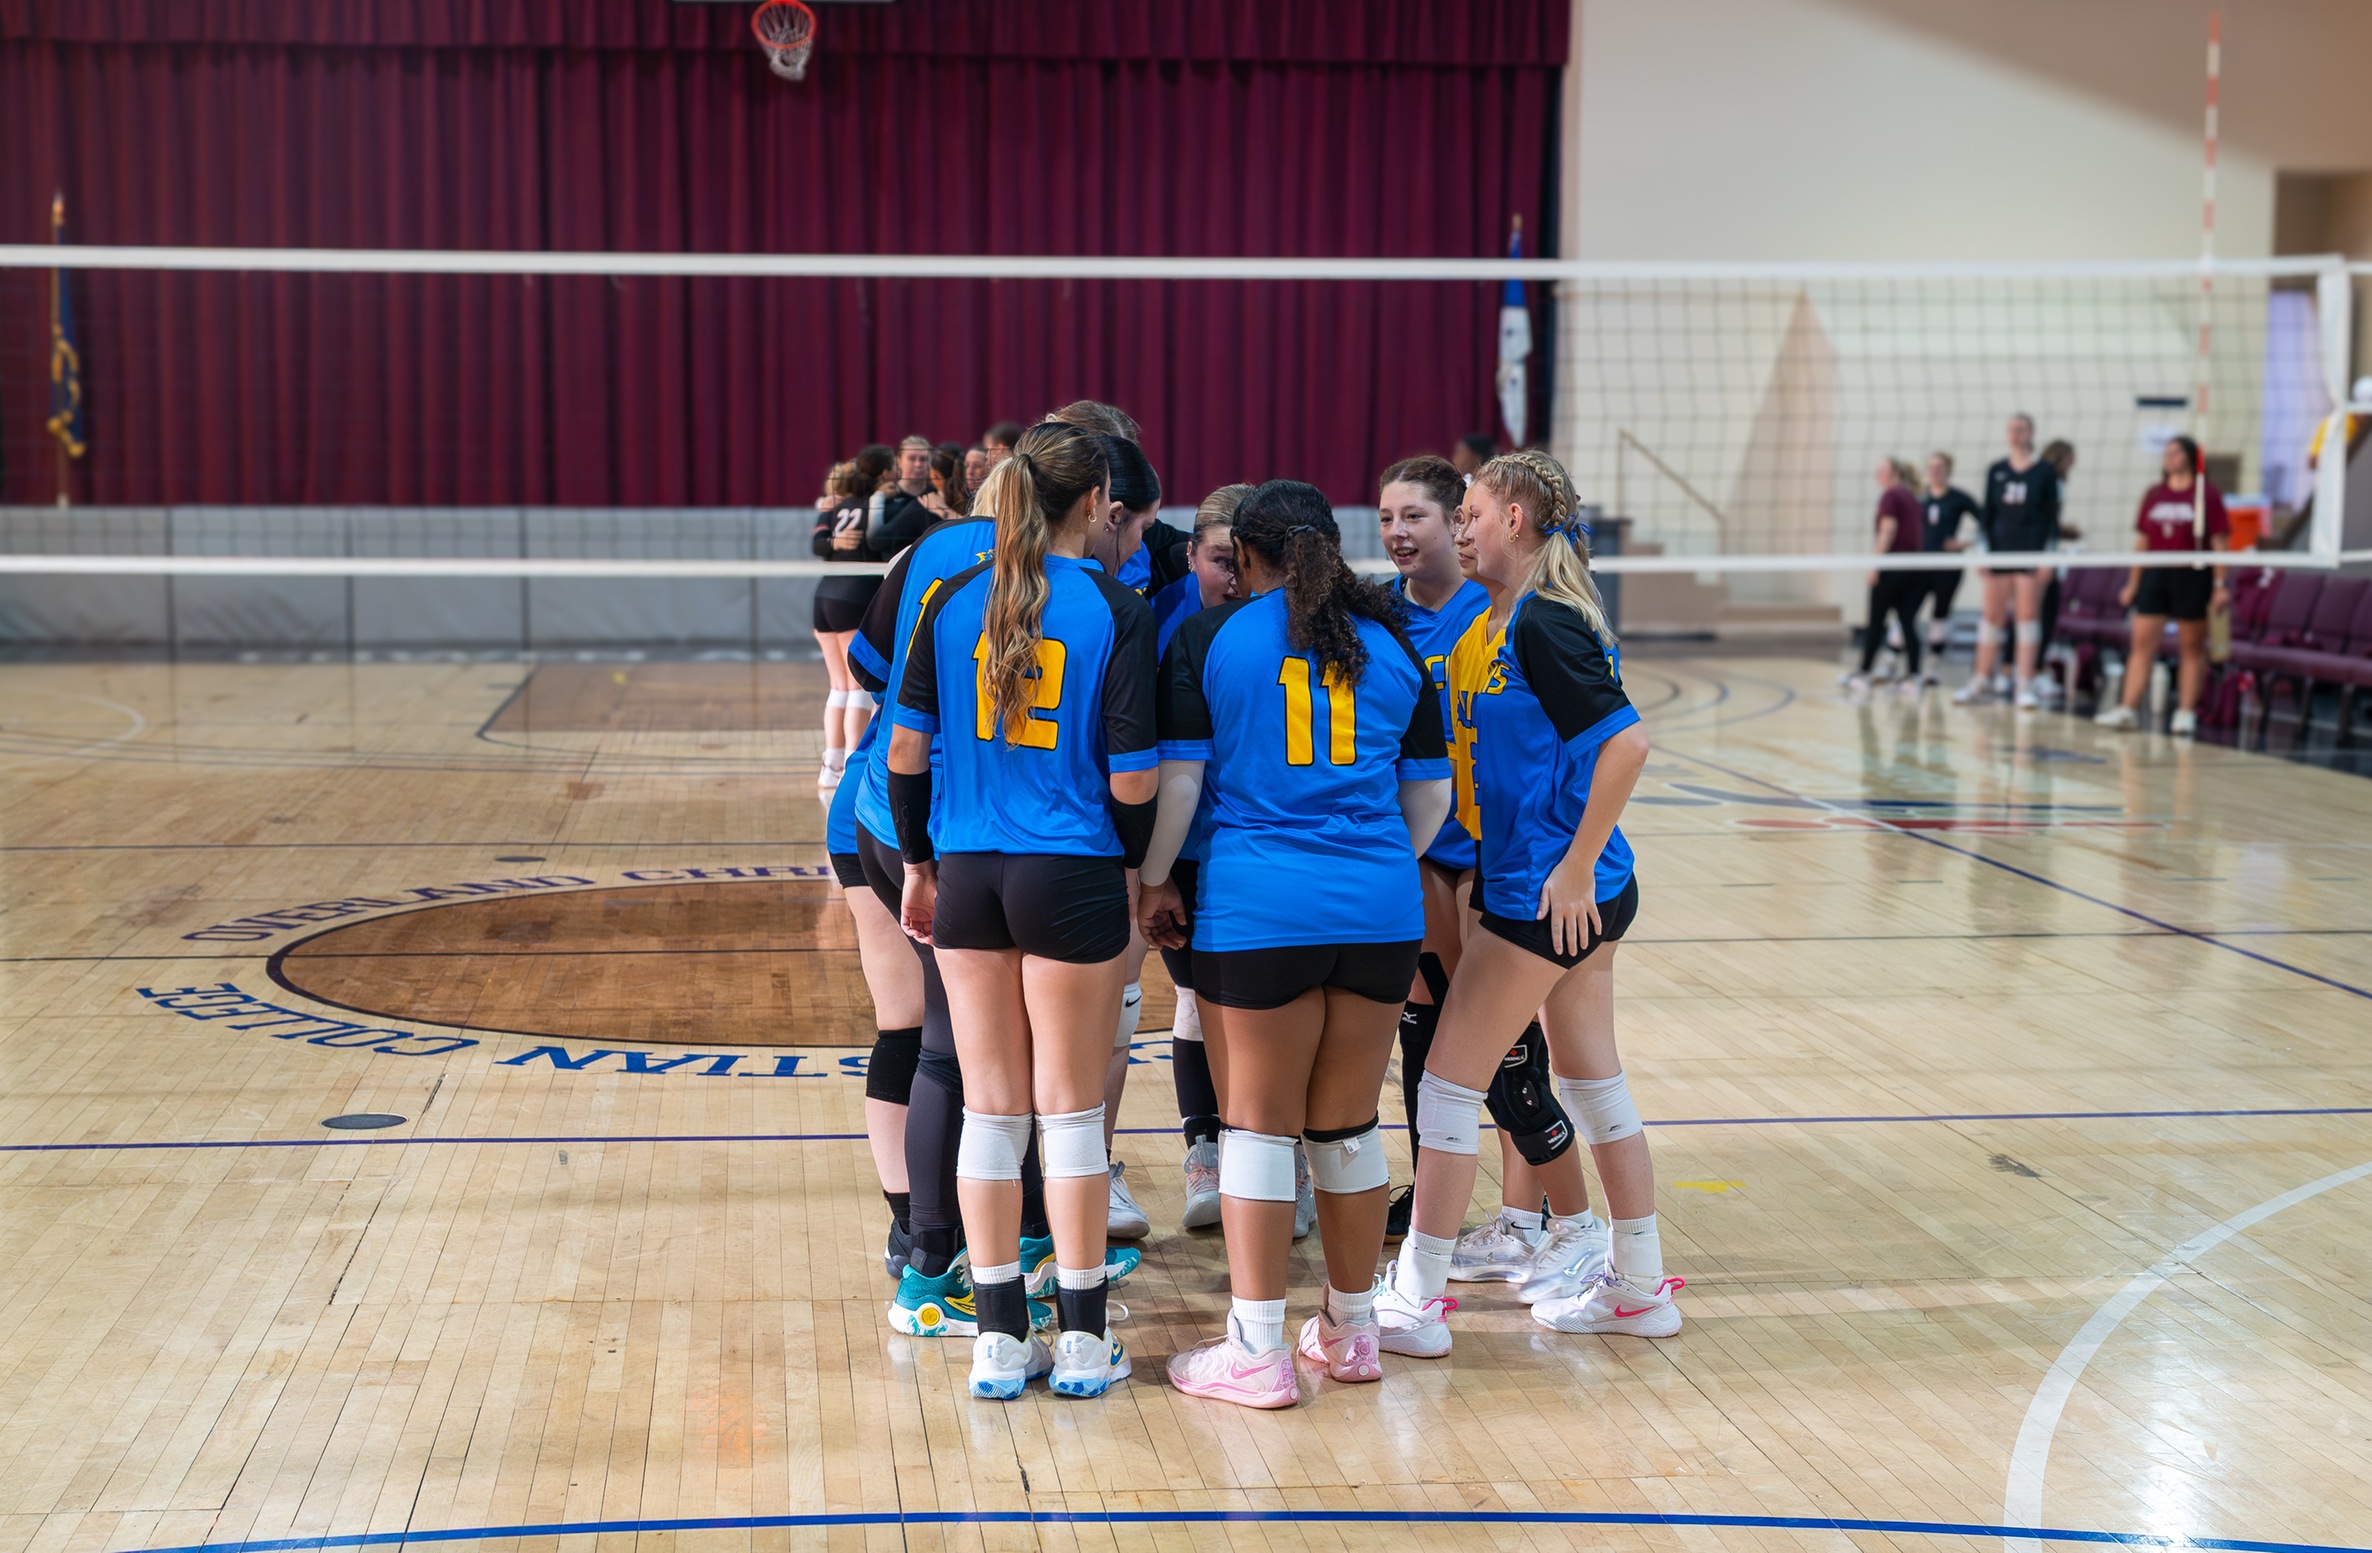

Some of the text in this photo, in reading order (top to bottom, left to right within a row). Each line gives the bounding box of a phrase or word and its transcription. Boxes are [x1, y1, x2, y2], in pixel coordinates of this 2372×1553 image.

[1276, 656, 1357, 766] 11
[180, 875, 596, 941] OVERLAND
[135, 983, 479, 1056] COLLEGE
